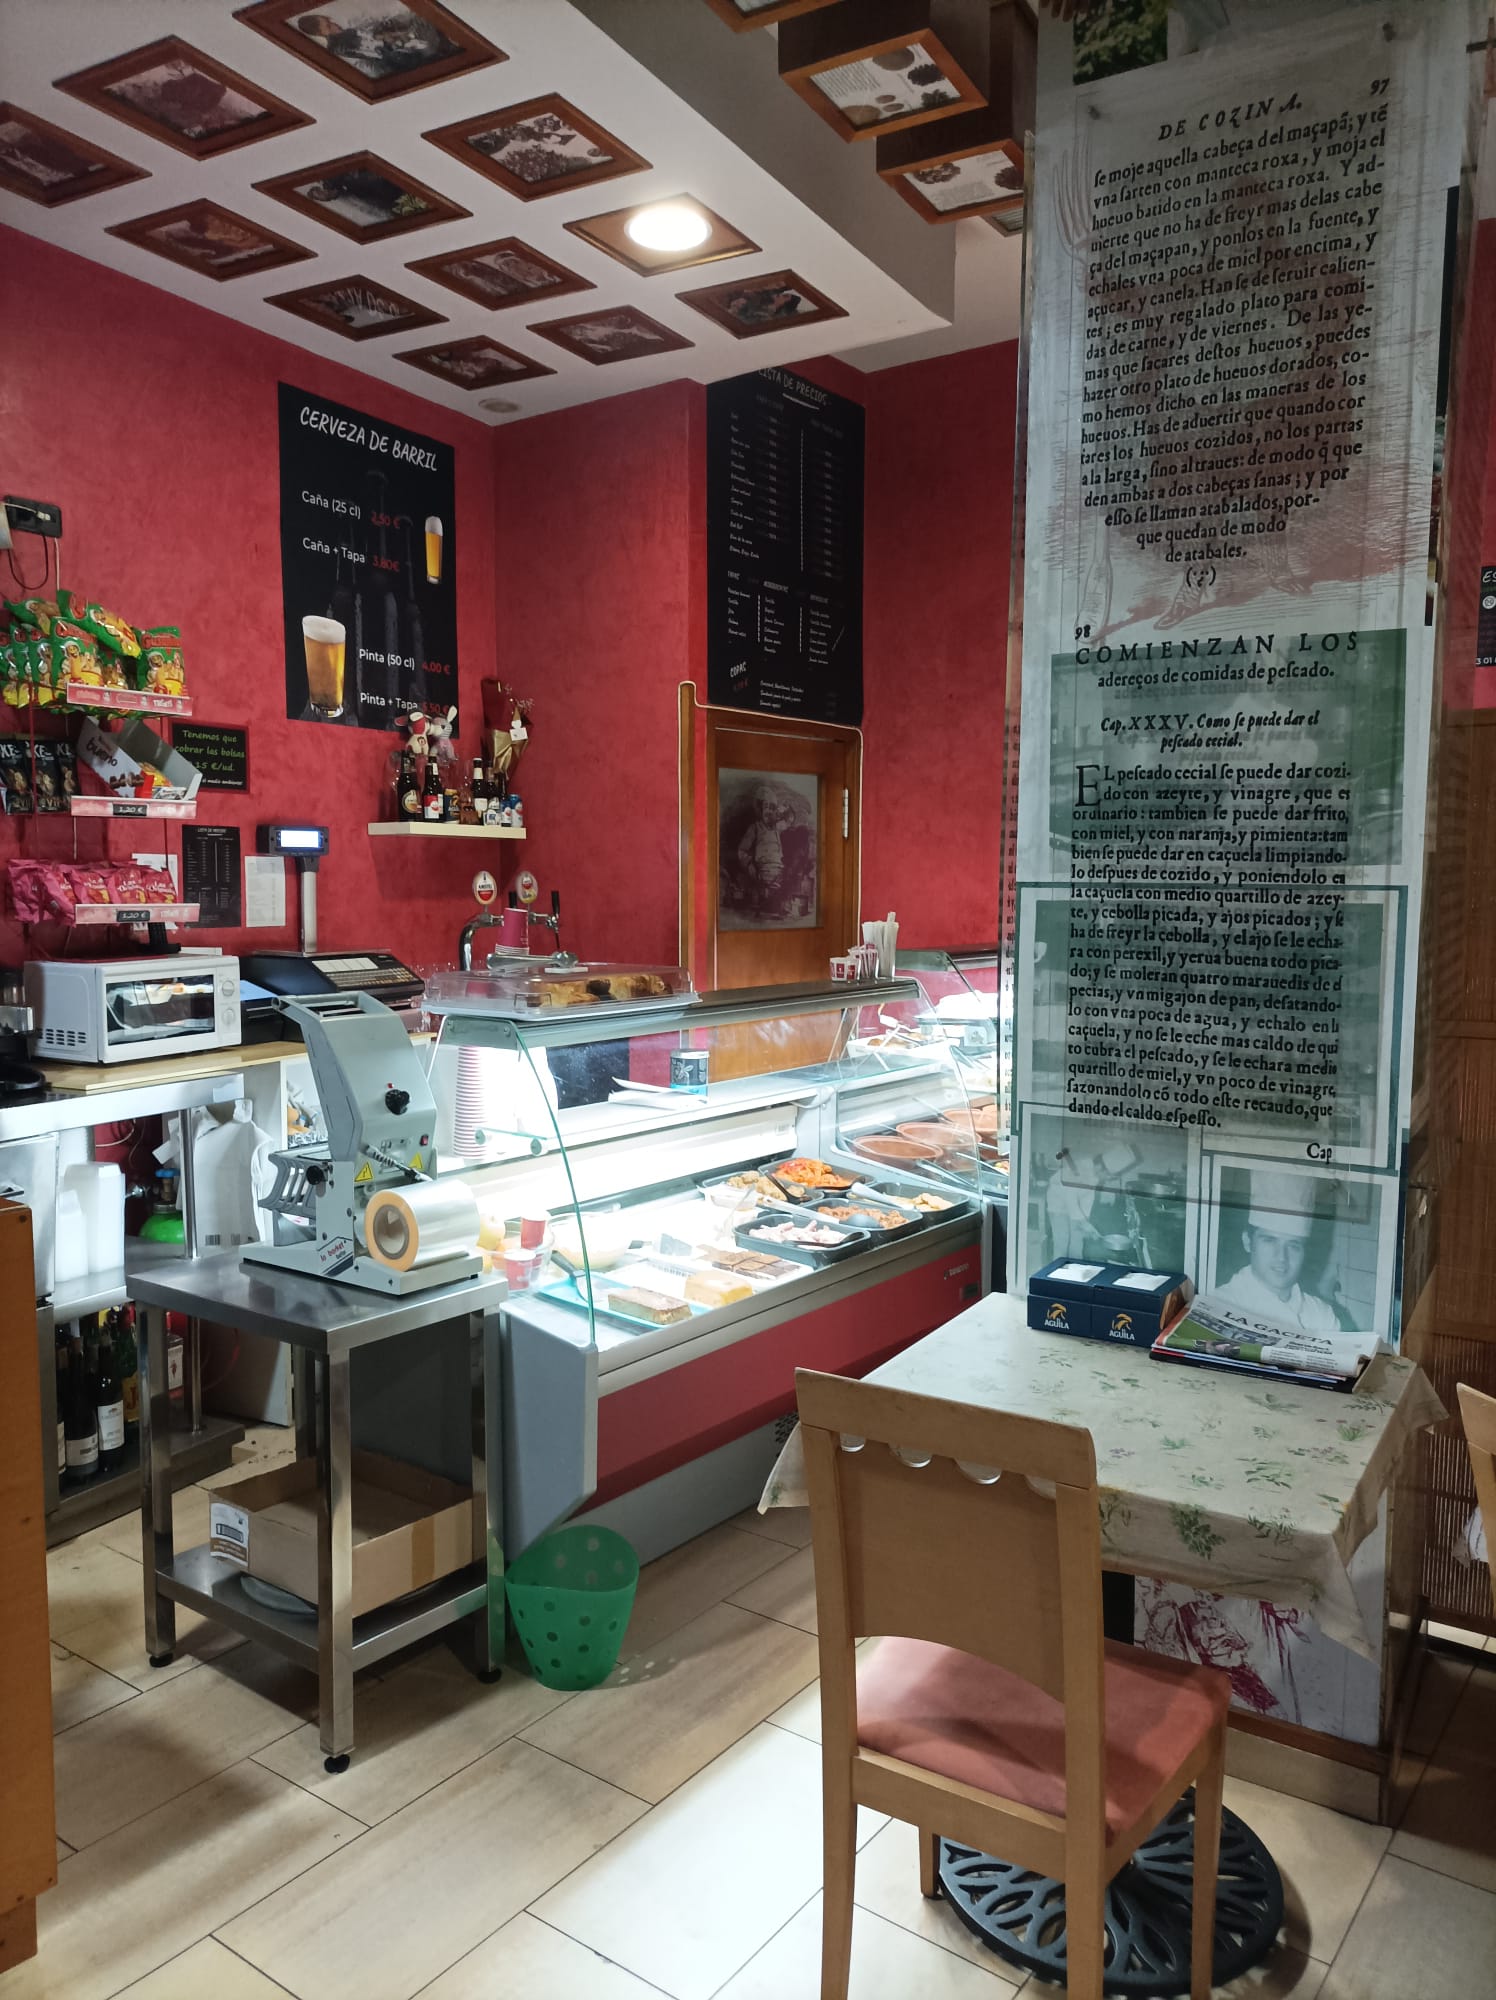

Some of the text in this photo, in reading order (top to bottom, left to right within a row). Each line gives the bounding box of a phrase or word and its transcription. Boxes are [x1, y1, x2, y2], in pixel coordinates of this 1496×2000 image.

[1369, 78, 1389, 95] 97
[1158, 120, 1186, 140] DE
[1108, 128, 1283, 183] moje aquella cabeça del
[1164, 138, 1366, 192] con manteca moja
[1136, 197, 1181, 221] batido
[1221, 179, 1283, 203] manteca
[1133, 180, 1382, 248] que mas cabe
[1104, 250, 1125, 270] del
[1212, 227, 1263, 254] ponlos
[1088, 273, 1136, 295] echales
[1169, 264, 1202, 285] poca
[1227, 248, 1261, 270] miel
[1264, 248, 1291, 268] por
[1131, 315, 1164, 332] muy
[1169, 299, 1234, 327] regalado
[1240, 294, 1279, 318] plato
[1282, 290, 1317, 311] para
[1287, 310, 1311, 328] De
[1113, 324, 1370, 381] que puedes
[1105, 371, 1366, 419] hemos dicho maneras los
[1119, 380, 1150, 397] otro
[1153, 374, 1191, 397] plato
[1133, 397, 1334, 437] Has quando
[300, 406, 437, 471] CERVEZA DE BARRIL
[1314, 418, 1363, 441] partas
[1268, 444, 1312, 464] modo
[1110, 485, 1154, 504] ambas
[1168, 481, 1192, 498] dos
[301, 490, 361, 519] Caña (25 cl)
[1150, 504, 1196, 522] llaman
[1136, 515, 1286, 548] que quedan modo
[302, 537, 330, 554] Caña
[341, 547, 365, 563] Tapa
[1074, 623, 1091, 639] 98
[359, 649, 415, 671] Pinta (50 cl)
[1075, 633, 1357, 665] COMIENZAN LOS
[1097, 666, 1243, 690] adereços comidas
[360, 693, 386, 707] Pinta
[396, 698, 418, 711] Tapa
[1196, 710, 1305, 732] Como puede dar
[182, 730, 237, 744] Tenemos que
[86, 736, 118, 767] bueno
[175, 744, 245, 758] cobrar las bolsas
[1174, 763, 1216, 780] cecial
[1236, 763, 1283, 783] puede
[1286, 762, 1310, 778] dar
[1149, 804, 1278, 825] tambien puede
[1116, 844, 1157, 864] puede
[1207, 845, 1262, 866] caçuela
[1238, 867, 1327, 887] poniendolo
[1164, 885, 1279, 906] medio quartillo
[1101, 903, 1310, 929] cebolla picados
[1158, 926, 1209, 943] cebolla
[1224, 949, 1307, 969] buena todo
[1119, 965, 1228, 988] moleran quatro
[1146, 986, 1205, 1008] migajon
[1138, 1009, 1305, 1031] poca echalo
[1221, 1033, 1293, 1050] mas caldo
[1243, 1053, 1291, 1071] echara
[1218, 1075, 1254, 1092] poco
[1174, 1087, 1208, 1105] todo
[1068, 1097, 1160, 1121] dando caldo
[1306, 1143, 1332, 1165] Cap
[1224, 1312, 1333, 1346] LA GACETA
